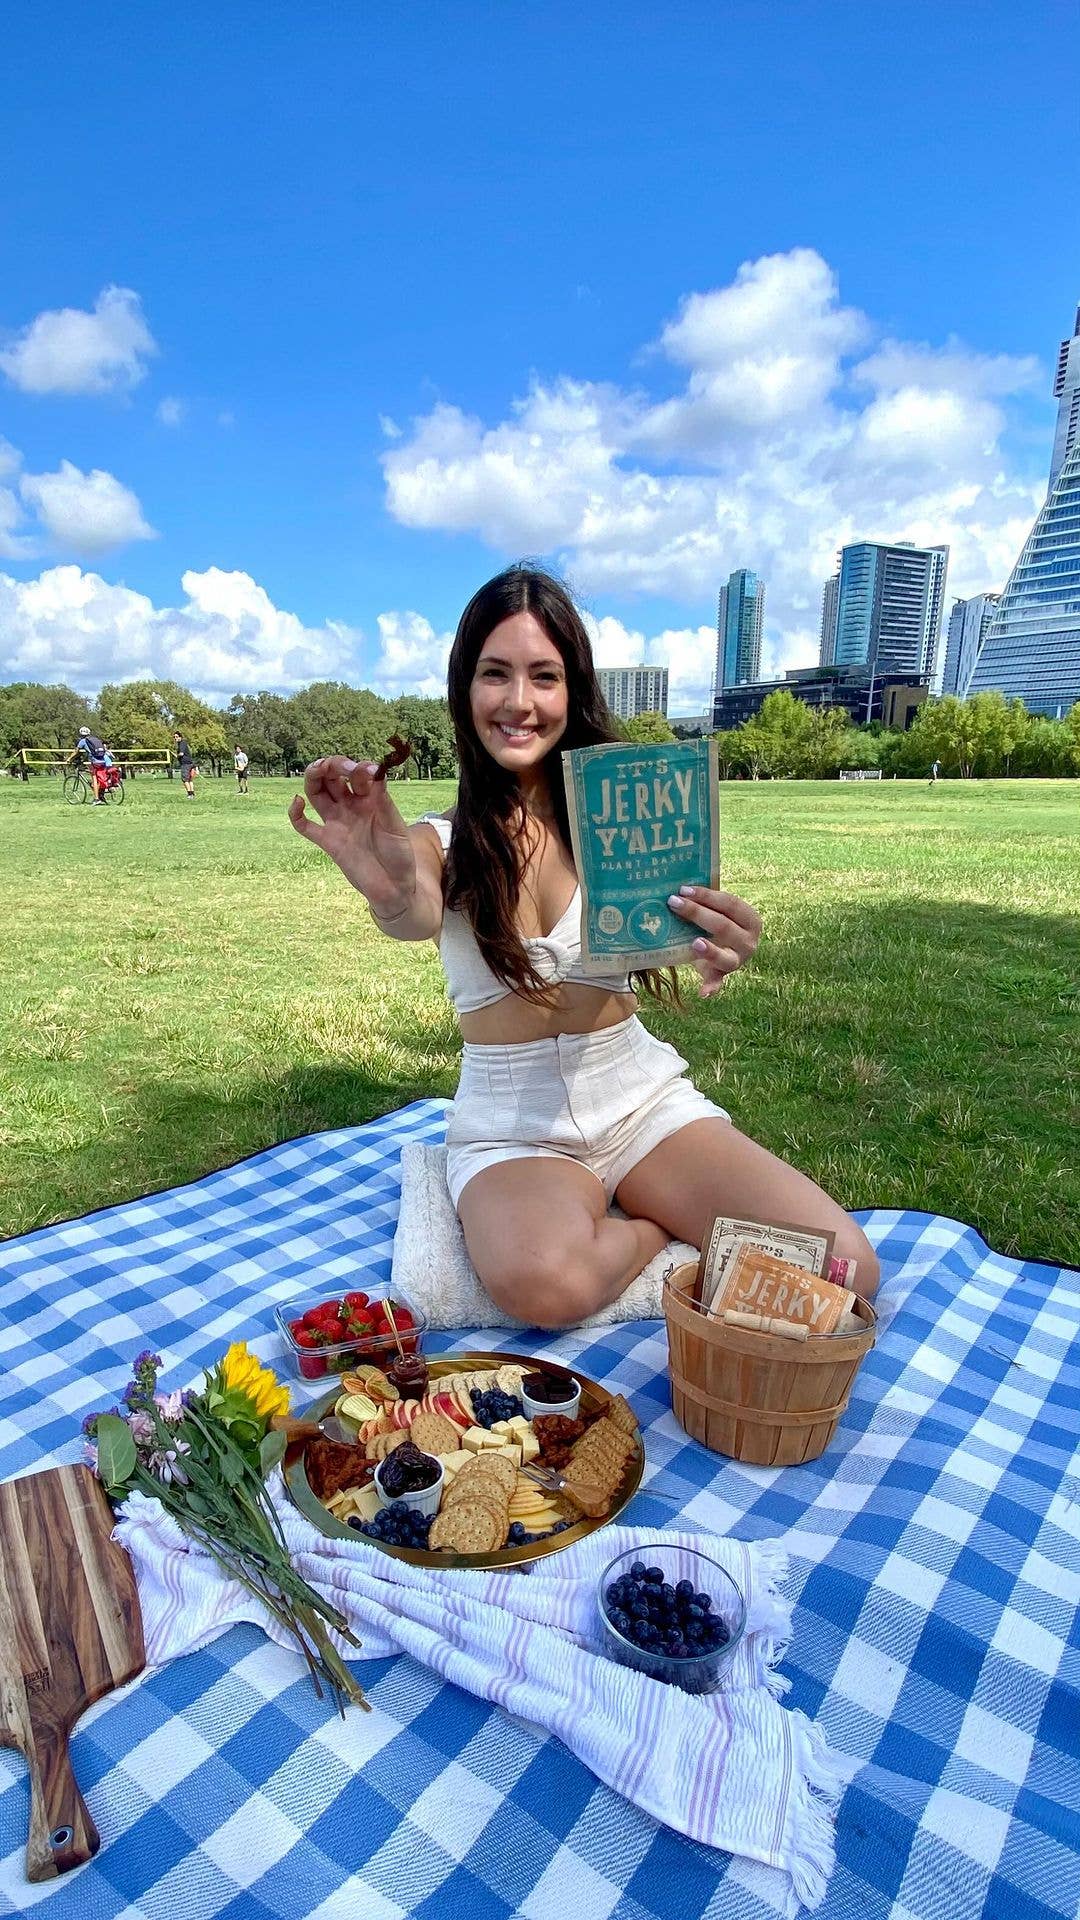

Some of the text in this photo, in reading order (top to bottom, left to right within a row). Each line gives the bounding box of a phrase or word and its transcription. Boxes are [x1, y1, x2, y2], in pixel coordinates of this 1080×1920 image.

[616, 758, 669, 779] IT'S
[592, 769, 693, 825] JERKY
[595, 819, 695, 857] Y'ALL
[601, 859, 642, 871] PLANT
[626, 867, 669, 881] JERKY
[767, 1266, 813, 1291] IT'S
[738, 1270, 832, 1326] JERKY
